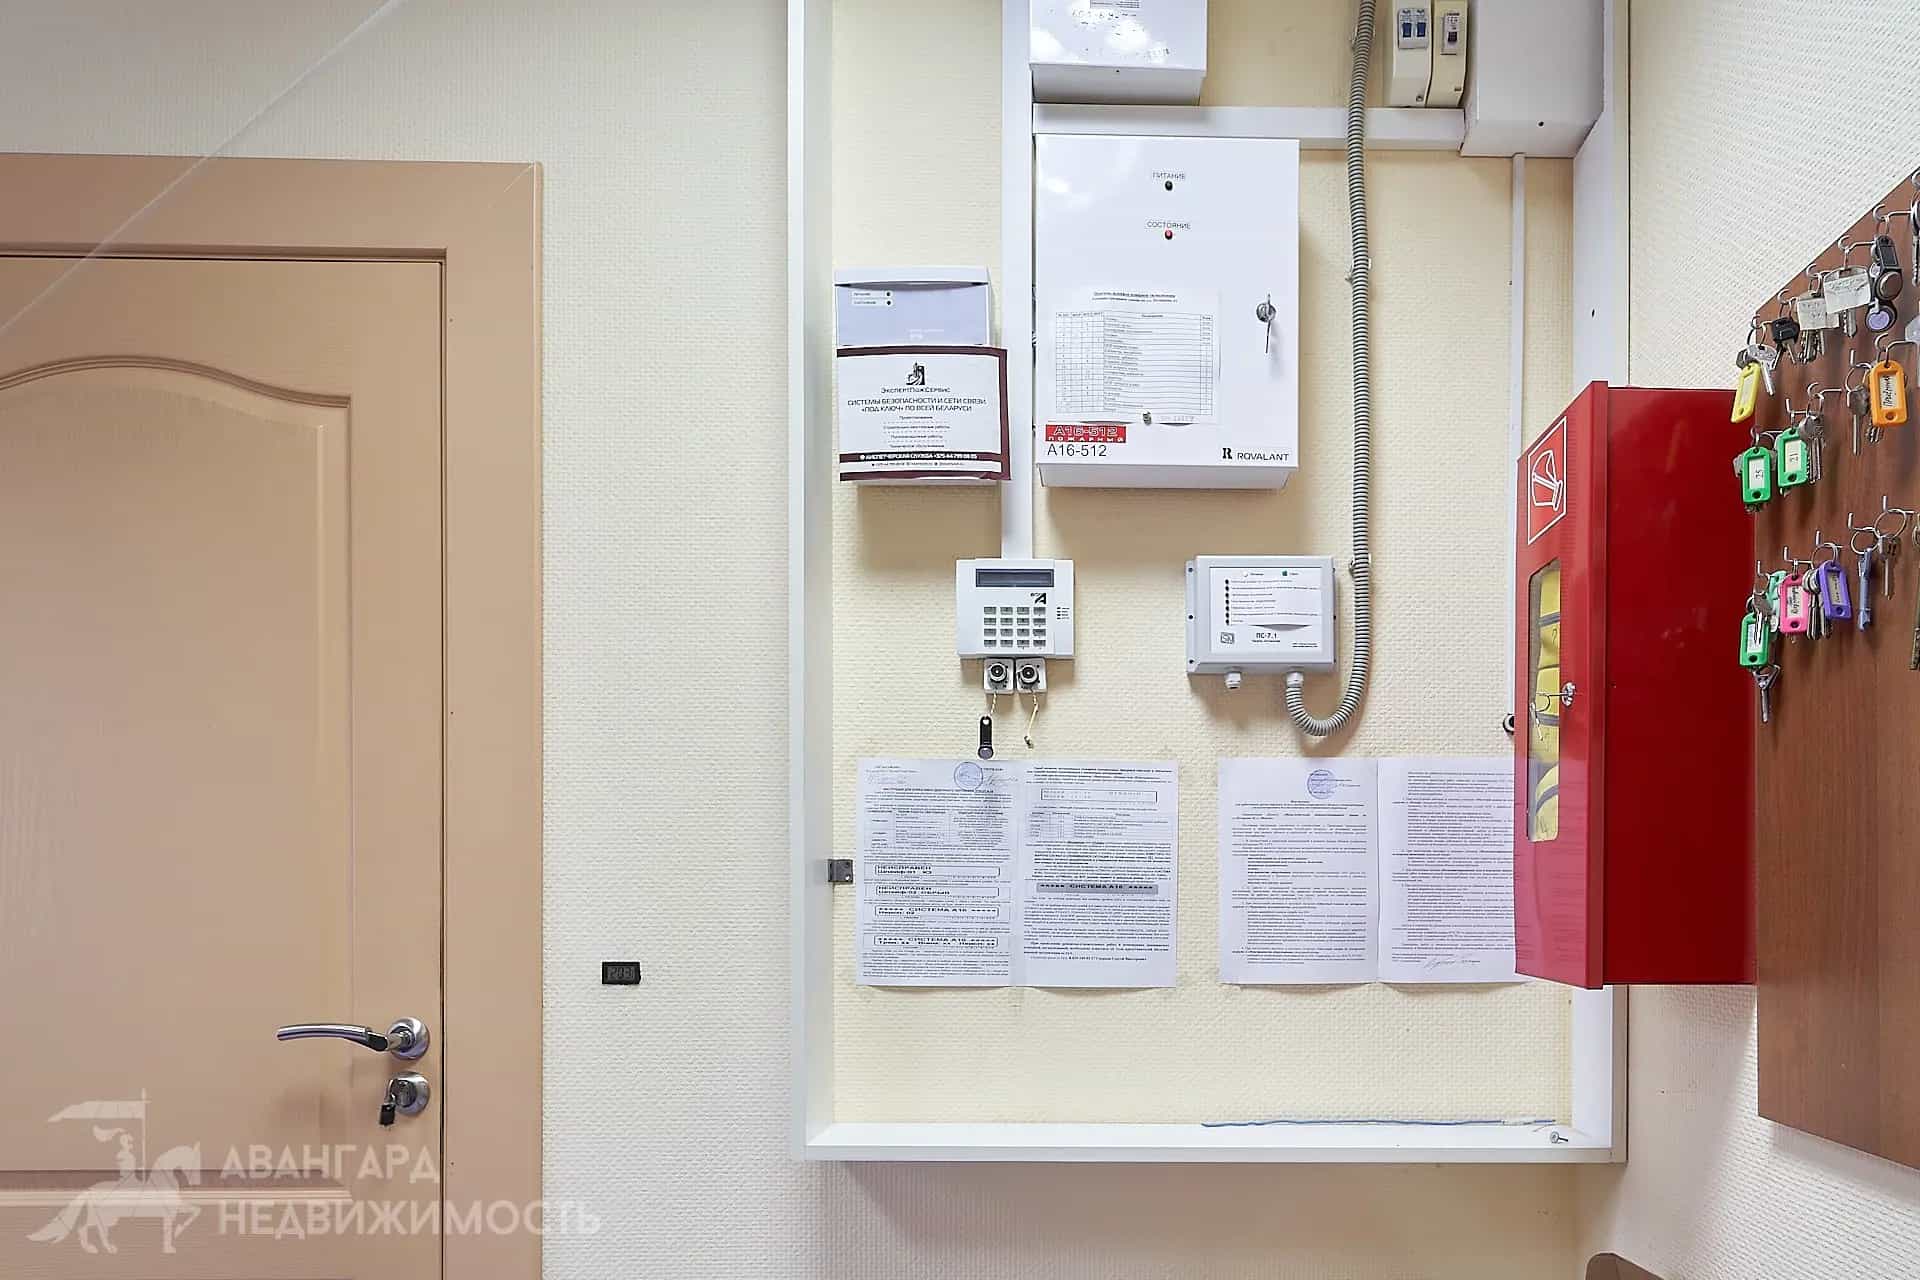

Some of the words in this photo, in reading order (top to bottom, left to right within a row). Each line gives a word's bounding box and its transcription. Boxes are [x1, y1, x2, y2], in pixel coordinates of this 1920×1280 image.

[1146, 221, 1191, 230] СОСТОЯНИЕ
[1047, 444, 1108, 457] A16-512
[1237, 452, 1289, 462] ROVALANT
